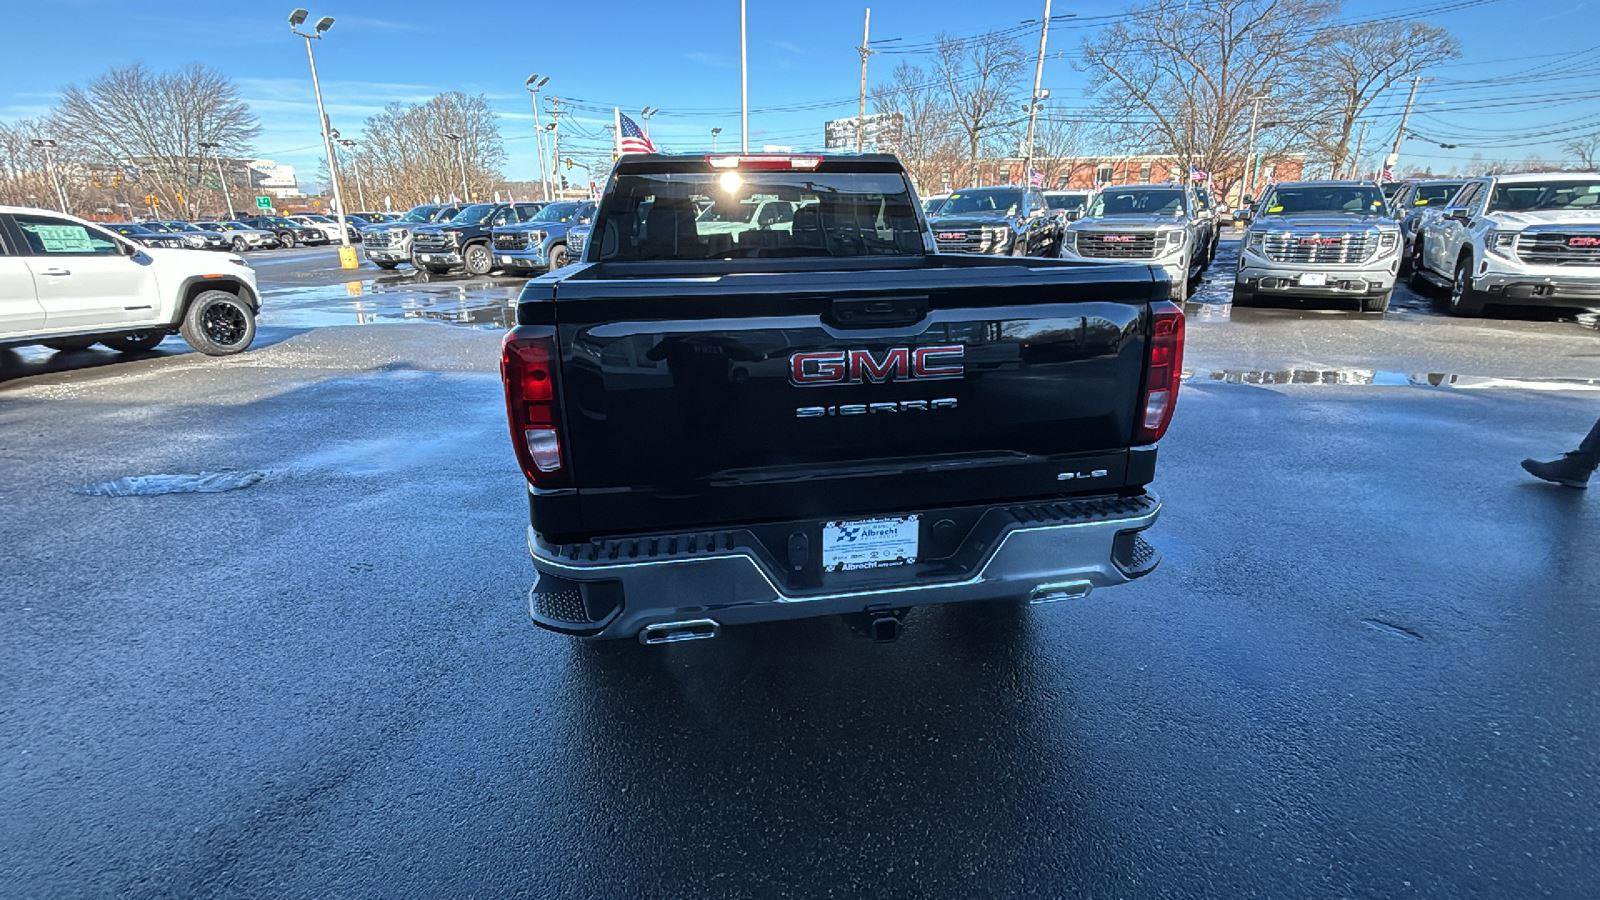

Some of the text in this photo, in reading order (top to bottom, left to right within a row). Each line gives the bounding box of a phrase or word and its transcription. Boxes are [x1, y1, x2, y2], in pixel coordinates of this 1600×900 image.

[788, 344, 965, 388] GMC
[796, 397, 958, 418] SIERRA
[861, 527, 898, 537] Albrecht
[841, 561, 878, 571] Albrecht
